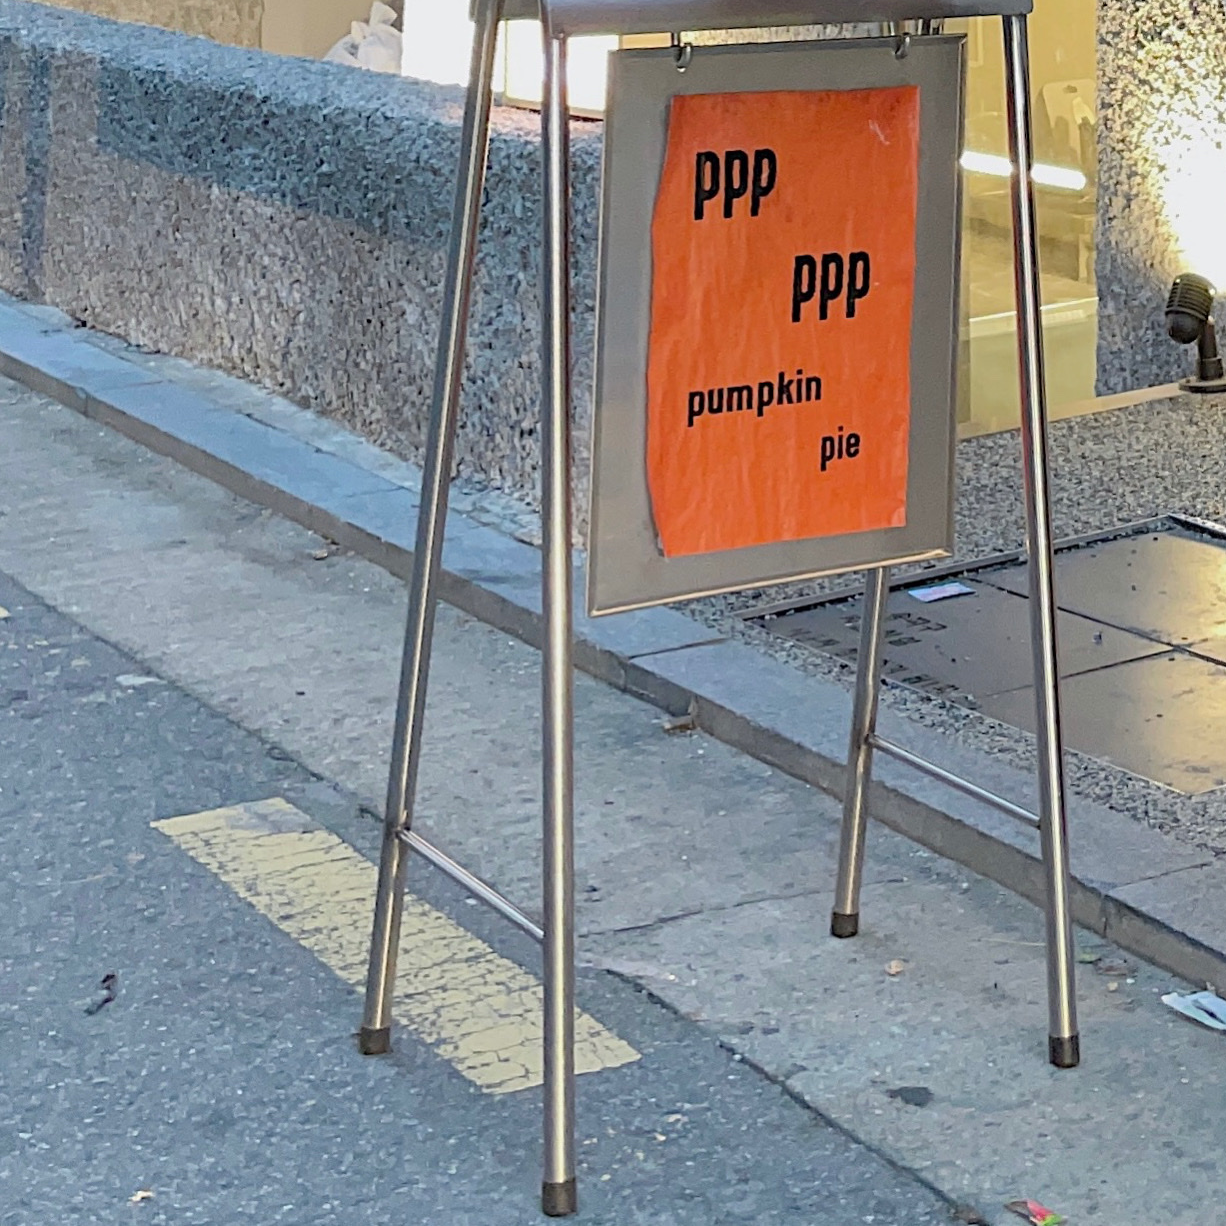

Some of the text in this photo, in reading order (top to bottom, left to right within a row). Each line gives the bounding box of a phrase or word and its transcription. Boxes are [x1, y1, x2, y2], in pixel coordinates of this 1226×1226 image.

[694, 148, 777, 220] ppp
[792, 251, 870, 322] ppp
[687, 369, 822, 427] pumpkin
[820, 426, 860, 471] pie
